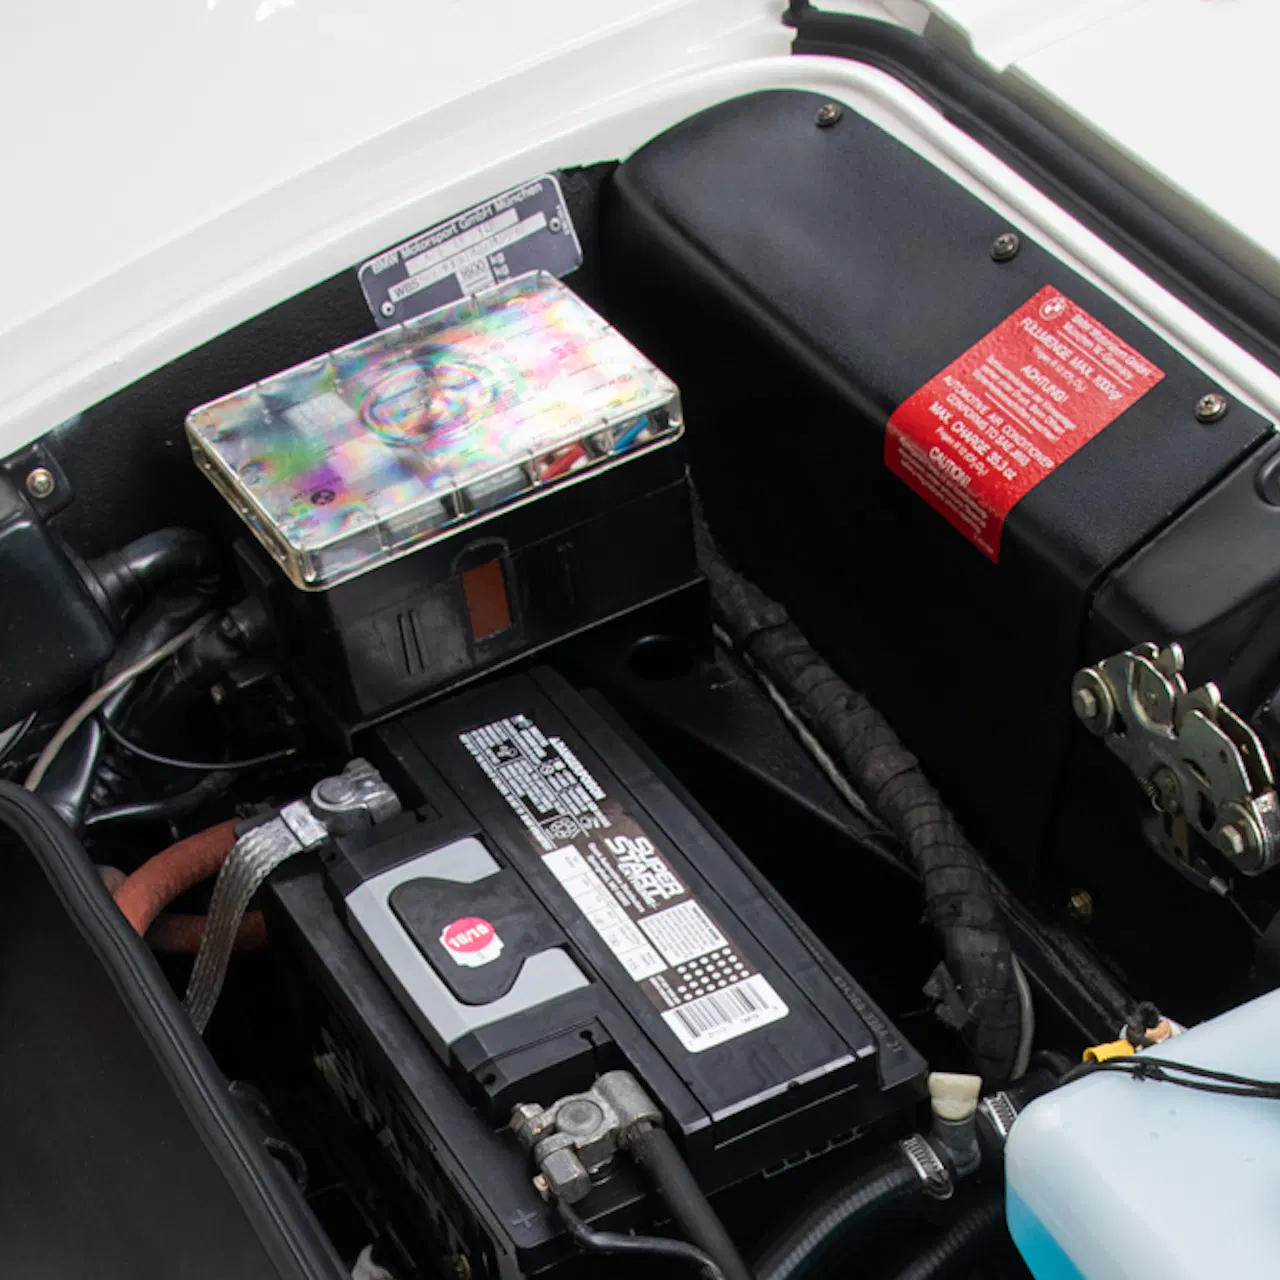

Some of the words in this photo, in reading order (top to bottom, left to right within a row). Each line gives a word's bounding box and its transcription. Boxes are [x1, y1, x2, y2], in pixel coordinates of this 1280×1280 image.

[401, 223, 458, 260] Motorsport
[459, 204, 494, 231] GmbH
[1017, 363, 1071, 405] ACHTUNG!
[939, 373, 993, 416] AUTOMOTIVE
[985, 411, 1005, 427] AIR
[998, 422, 1058, 470] CONDITIONER
[946, 419, 993, 456] CHARGE
[982, 424, 1002, 440] TO
[604, 835, 669, 899] START
[634, 836, 685, 896] SUPER
[448, 923, 490, 948] 10/16
